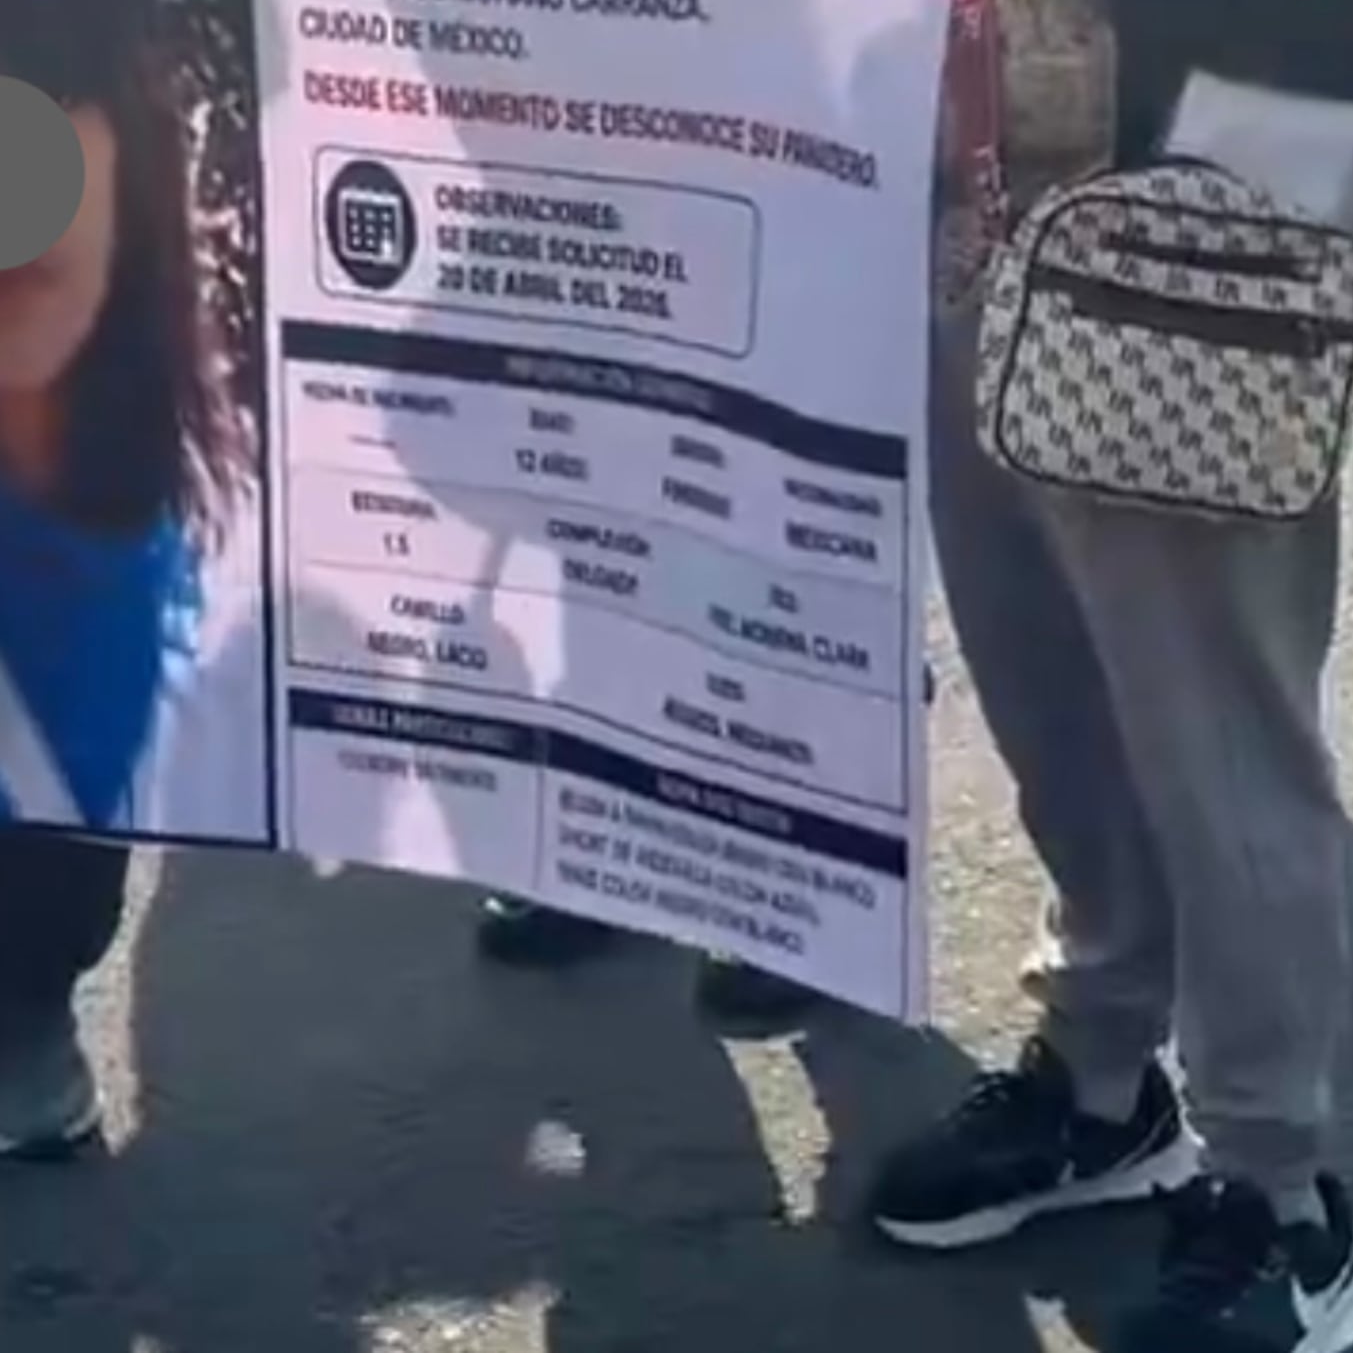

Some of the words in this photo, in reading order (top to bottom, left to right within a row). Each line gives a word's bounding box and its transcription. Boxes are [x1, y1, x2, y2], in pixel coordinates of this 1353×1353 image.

[299, 7, 387, 45] CIUDAD
[392, 18, 423, 50] DE
[302, 70, 381, 112] DESDE
[386, 78, 428, 117] ESE
[433, 85, 561, 132] MOMENTO
[565, 100, 595, 135] SE
[599, 101, 745, 154] DESCONOCE
[749, 122, 780, 160] SU
